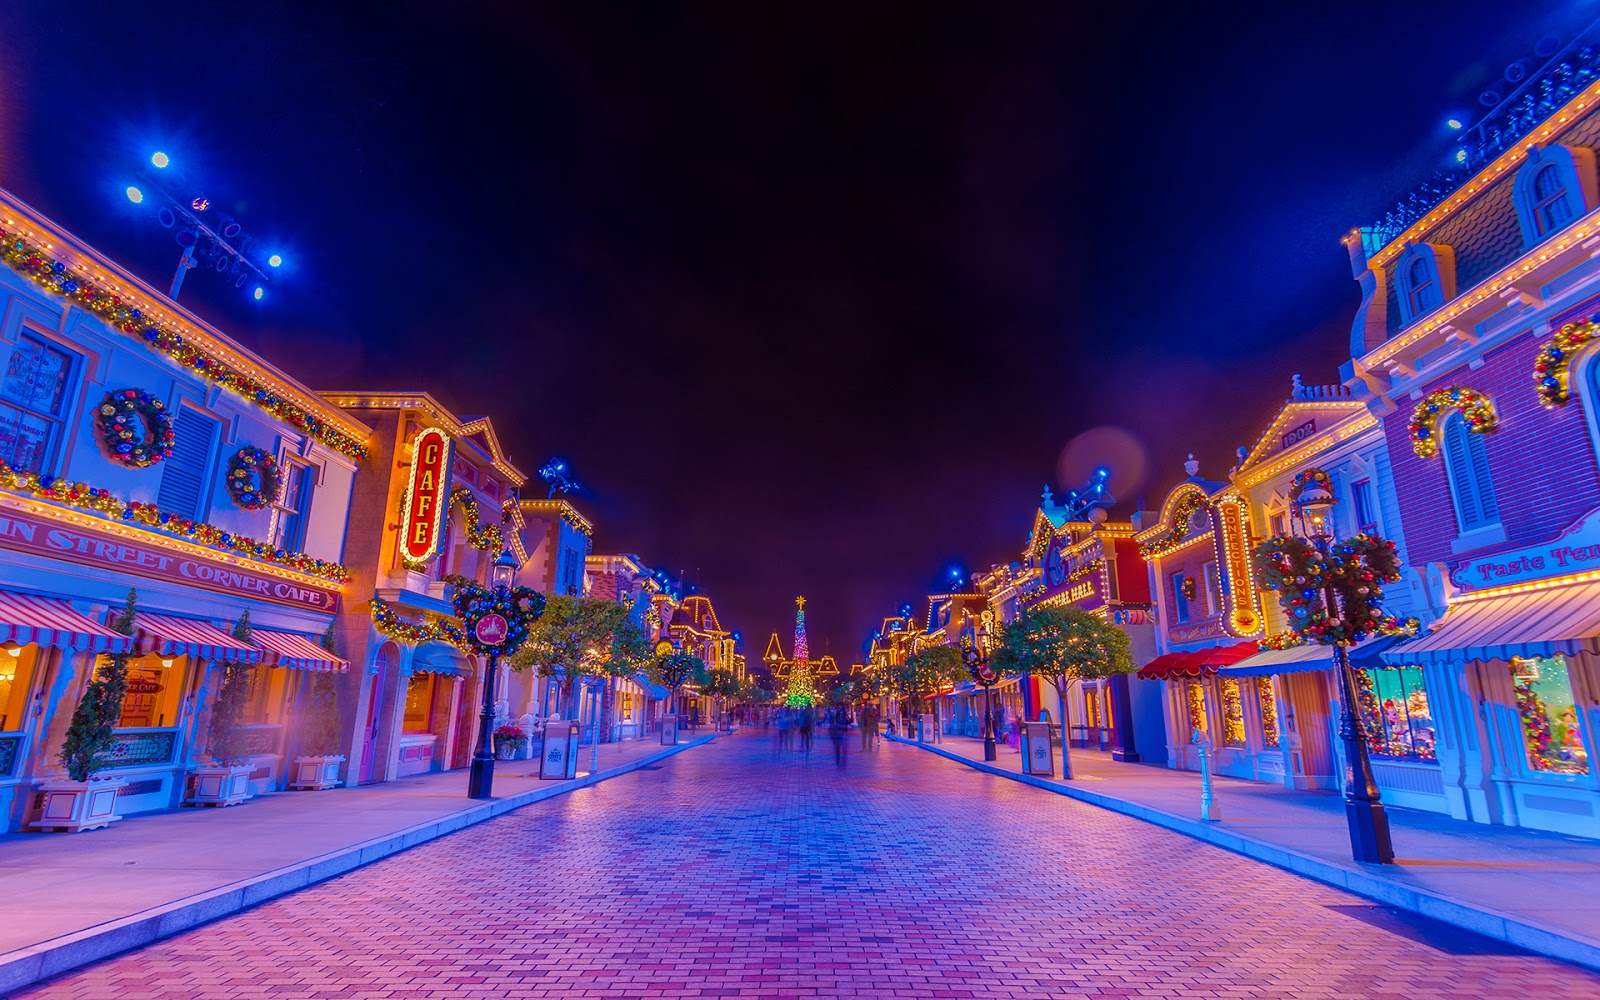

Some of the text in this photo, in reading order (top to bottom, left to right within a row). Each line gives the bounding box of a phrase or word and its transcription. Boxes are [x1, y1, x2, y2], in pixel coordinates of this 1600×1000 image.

[1283, 423, 1314, 448] 1902
[413, 444, 438, 544] CAFE
[45, 529, 174, 571] STREET
[179, 560, 270, 596] CORNER
[274, 583, 321, 604] CAFE
[1225, 507, 1247, 606] CONFECTIONS
[1477, 555, 1545, 581] Taste
